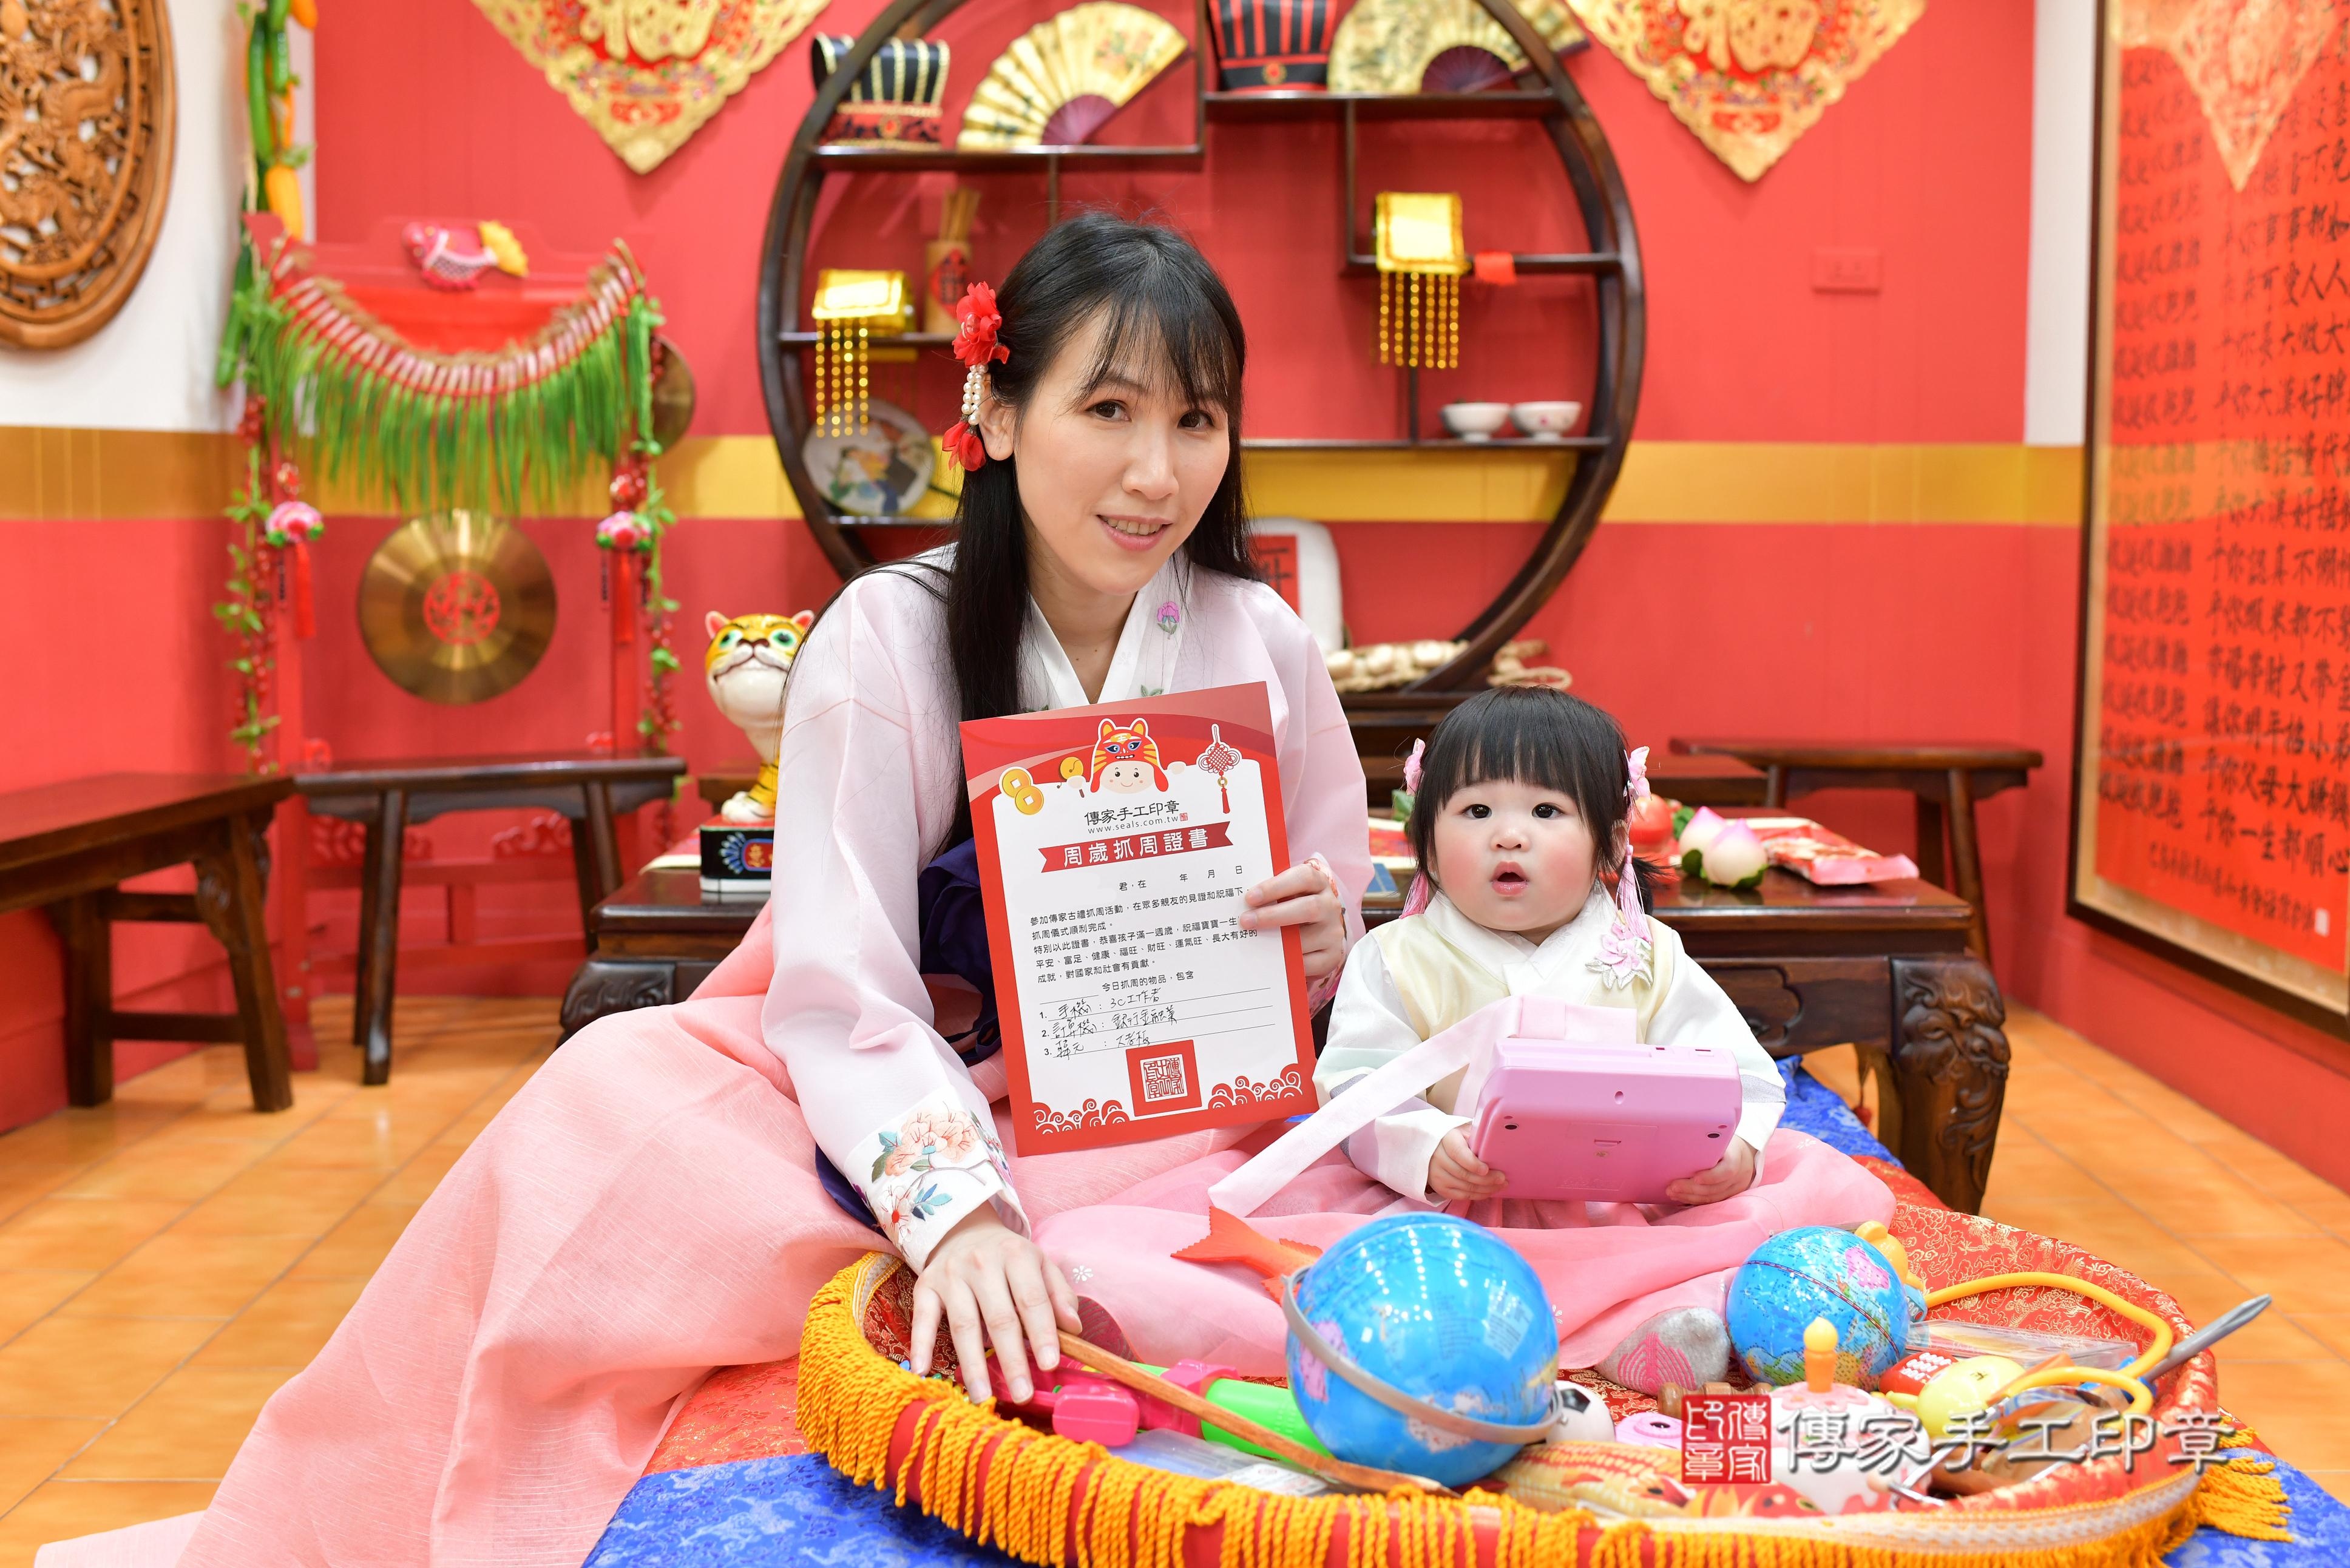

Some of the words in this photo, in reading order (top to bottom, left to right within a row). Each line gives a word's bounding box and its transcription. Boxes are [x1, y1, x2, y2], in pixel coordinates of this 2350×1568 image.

[1084, 799, 1180, 826] 傳家手工印章
[1088, 815, 1179, 834] www.seals.com.tw
[1063, 828, 1209, 868] 周歲抓周證書
[1179, 873, 1188, 882] 年
[1207, 869, 1216, 879] 月
[1235, 865, 1243, 875] 日
